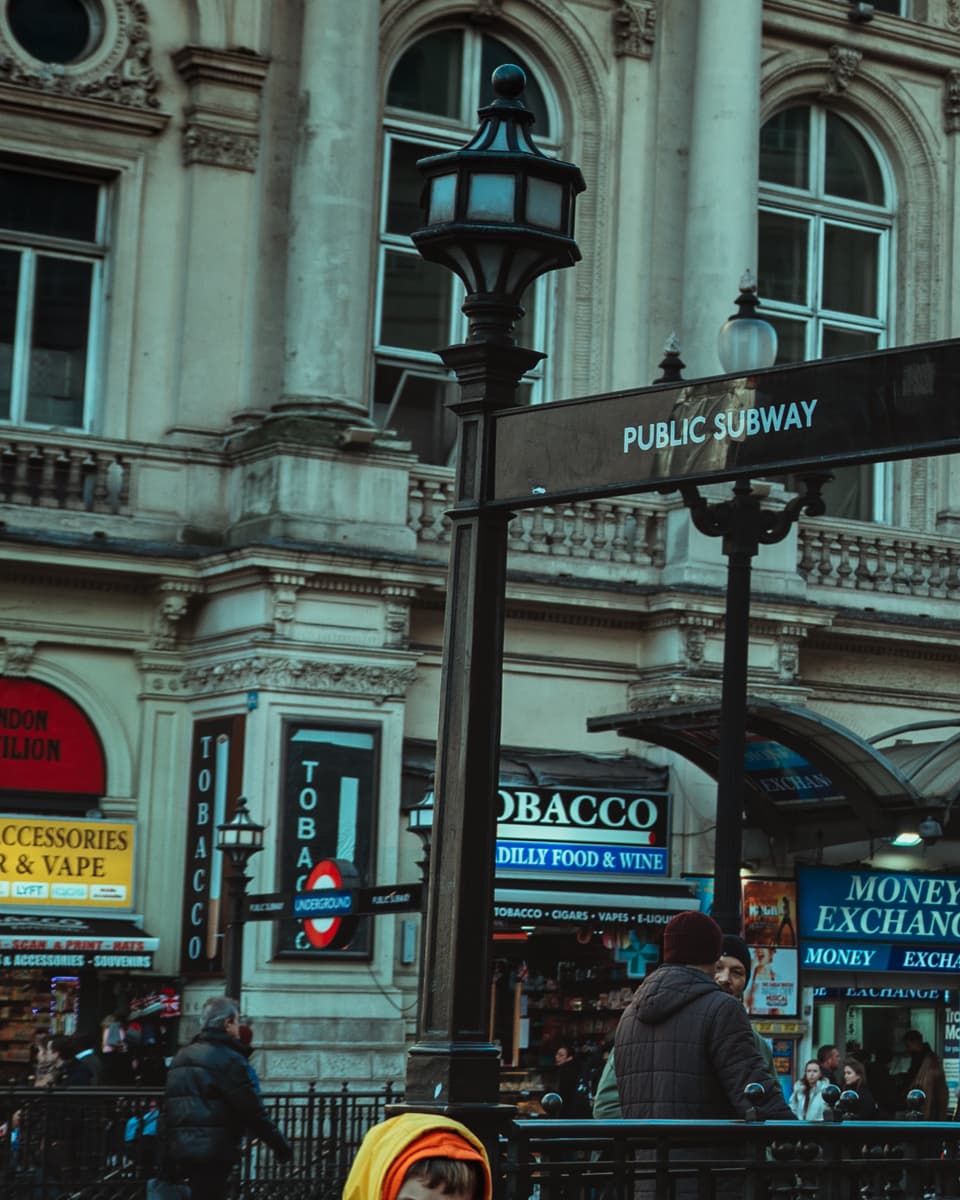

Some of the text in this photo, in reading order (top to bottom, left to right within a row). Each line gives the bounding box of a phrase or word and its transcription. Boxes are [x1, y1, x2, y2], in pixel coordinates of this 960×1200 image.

[623, 399, 818, 454] PUBLIC SUBWAY
[0, 734, 61, 763] ILION
[0, 824, 129, 851] CCESSORIES
[188, 735, 214, 960] TOBACCO
[16, 853, 35, 875] &
[41, 854, 107, 878] VAPE
[495, 846, 664, 871] DILLY FOOD & WINE
[294, 896, 352, 912] UNDERGROUND
[494, 906, 542, 918] TOBACCO
[551, 911, 589, 921] CIGARS
[598, 911, 629, 922] VAPES
[13, 954, 84, 966] ACCESSORIES
[93, 955, 151, 967] SOUVENIRS
[804, 948, 876, 966] MONEY
